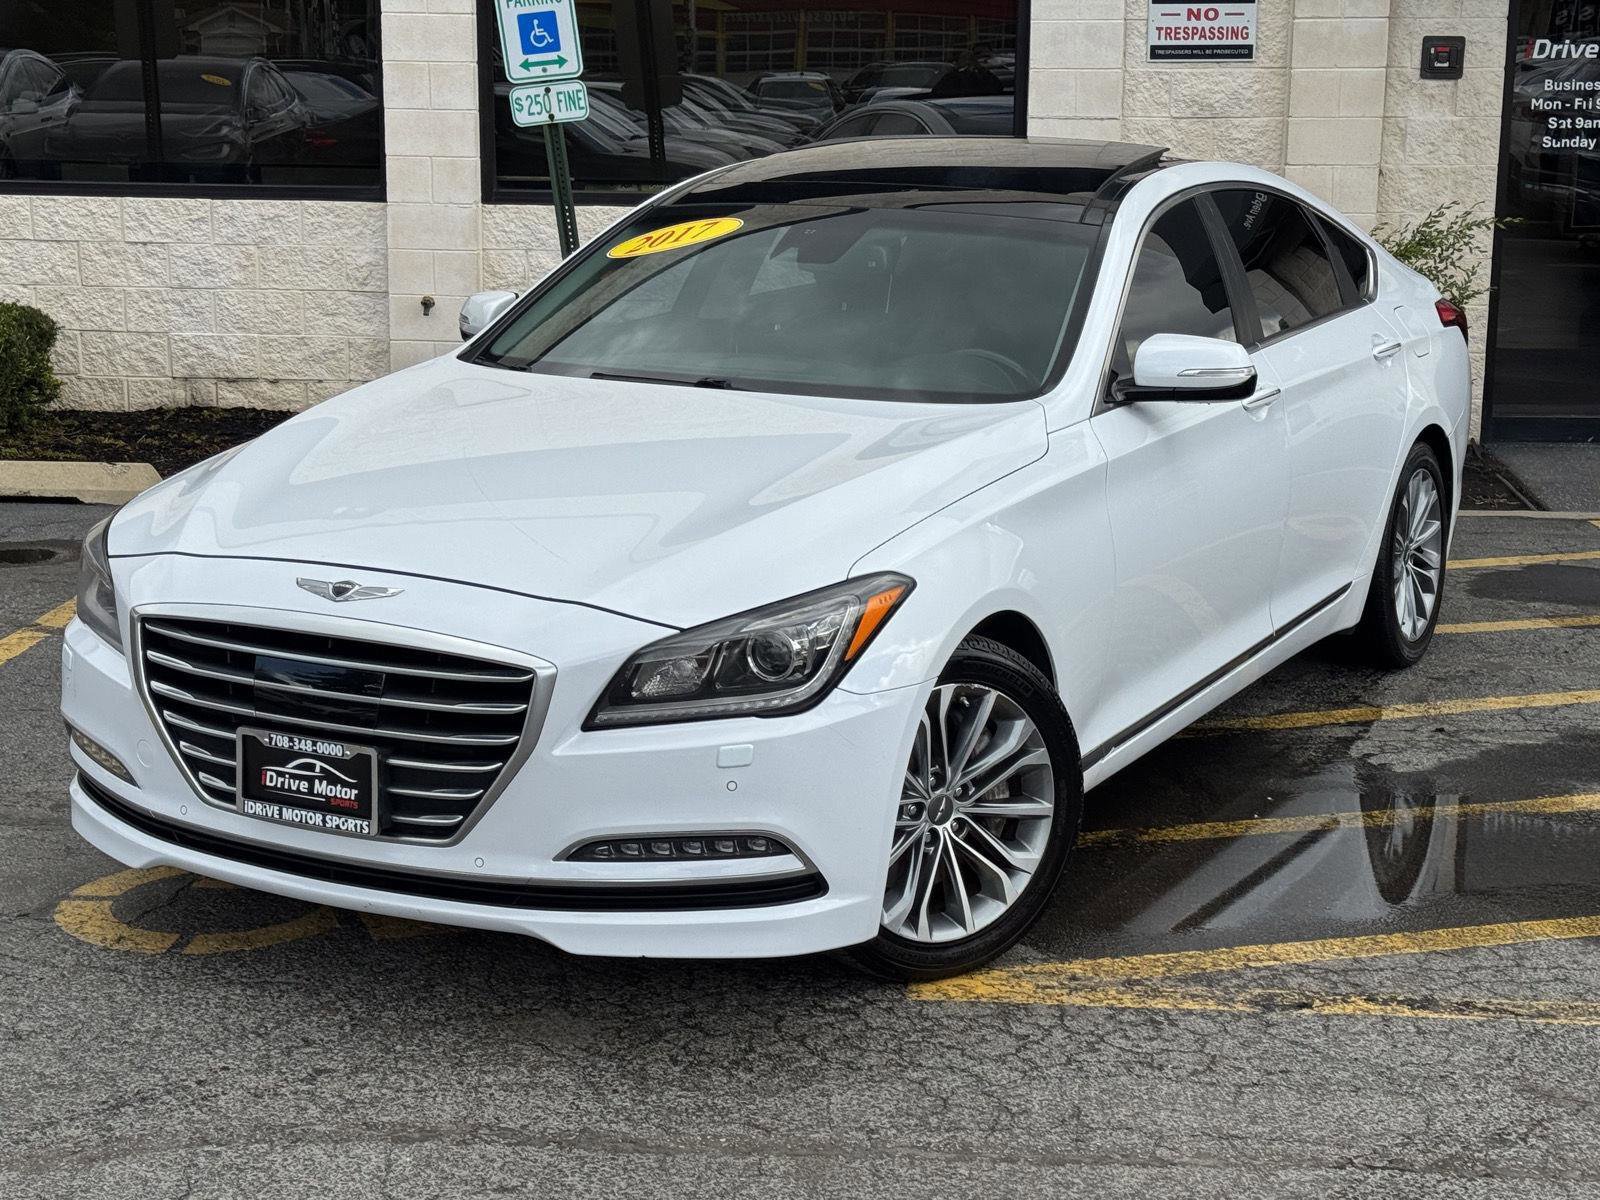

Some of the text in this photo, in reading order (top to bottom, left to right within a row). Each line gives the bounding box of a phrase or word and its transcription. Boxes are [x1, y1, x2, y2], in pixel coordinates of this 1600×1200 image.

[1186, 7, 1219, 21] NO
[1155, 25, 1250, 41] TRESPASSING
[1544, 79, 1600, 91] Busines
[514, 89, 586, 117] $250 FINE
[1531, 98, 1562, 110] Mon
[1548, 117, 1572, 129] Sat
[1542, 135, 1597, 150] Sunday
[623, 220, 720, 255] 2017
[270, 733, 343, 757] 708-348-0000
[261, 769, 359, 801] iDrive Motor
[330, 798, 359, 809] SPORTS
[282, 807, 324, 827] MOTOR
[325, 817, 370, 834] SPORTS
